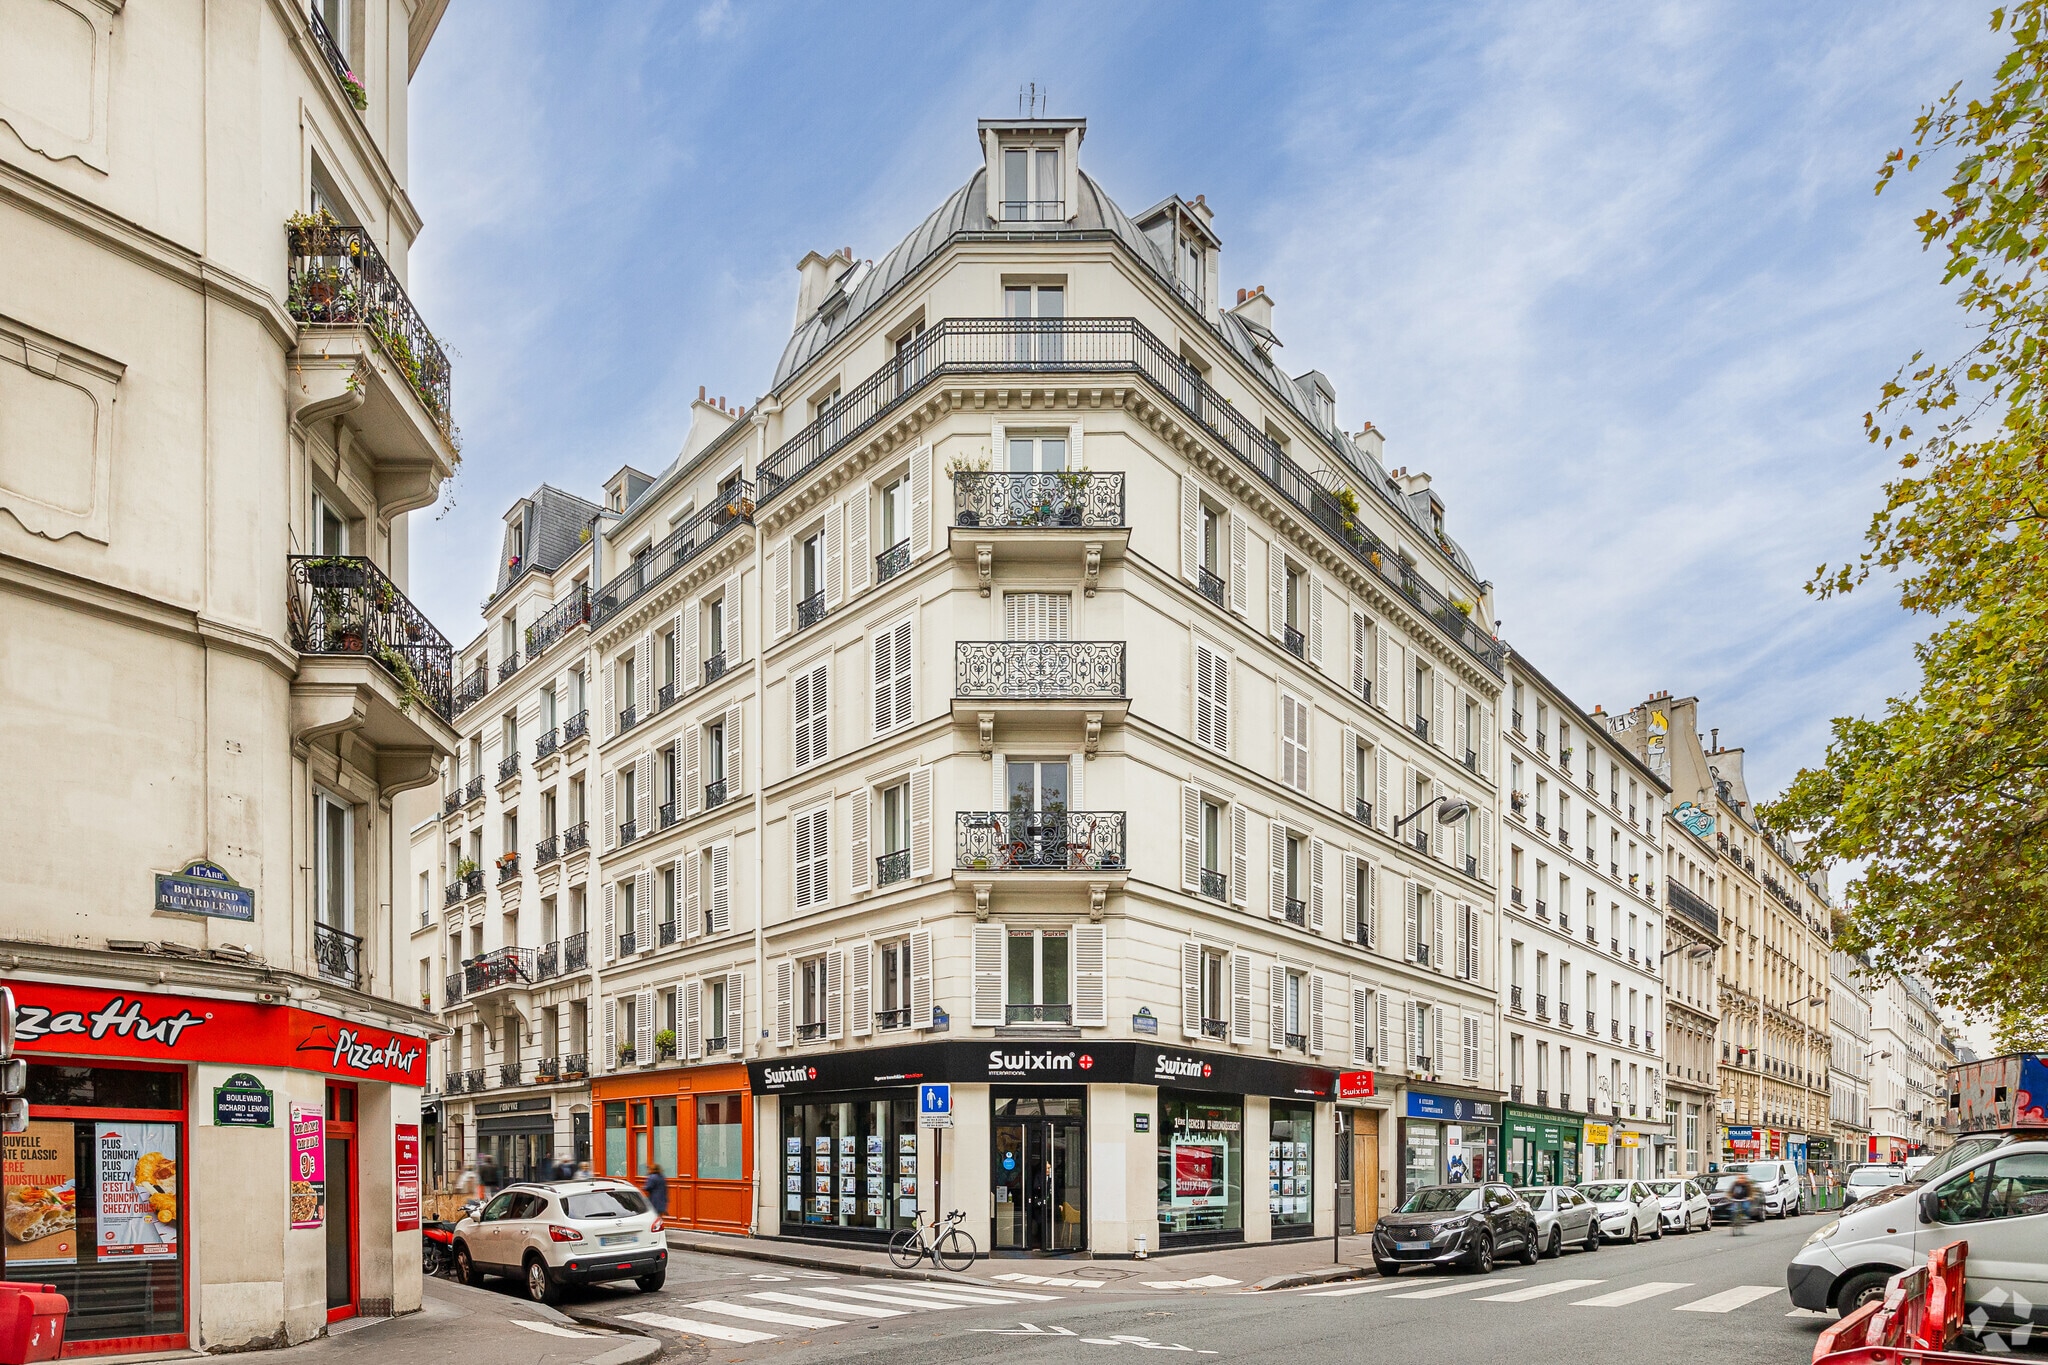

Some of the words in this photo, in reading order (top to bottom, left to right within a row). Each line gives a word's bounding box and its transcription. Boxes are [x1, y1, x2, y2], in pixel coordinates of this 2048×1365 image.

[174, 884, 239, 901] BOULEVARD
[161, 894, 210, 908] RICHARD
[212, 901, 249, 914] LENOIR
[91, 999, 204, 1045] Hut
[333, 1028, 384, 1070] Pizza
[384, 1036, 419, 1074] Hut
[988, 1050, 1073, 1070] Swixim
[1155, 1054, 1202, 1077] Swixim
[764, 1065, 808, 1084] Swixim
[226, 1094, 262, 1102] BOULEVARD
[218, 1103, 246, 1112] RICHARD
[247, 1104, 269, 1112] LENOIR
[3, 1136, 41, 1147] OUVELLE
[102, 1139, 121, 1149] PLUS
[3, 1147, 18, 1160] ÂTE
[21, 1149, 58, 1160] CLASSIC
[3, 1160, 25, 1172] ÉRÉE
[102, 1161, 121, 1171] PLUS
[4, 1174, 67, 1186] ROUSTILLANTE
[102, 1172, 131, 1181] CHEEZY
[102, 1182, 123, 1192] C'EST
[126, 1182, 135, 1192] LA
[1176, 1178, 1209, 1191] Swixim
[102, 1193, 139, 1203] CRUNCHY
[103, 1203, 132, 1214] CHEEZY
